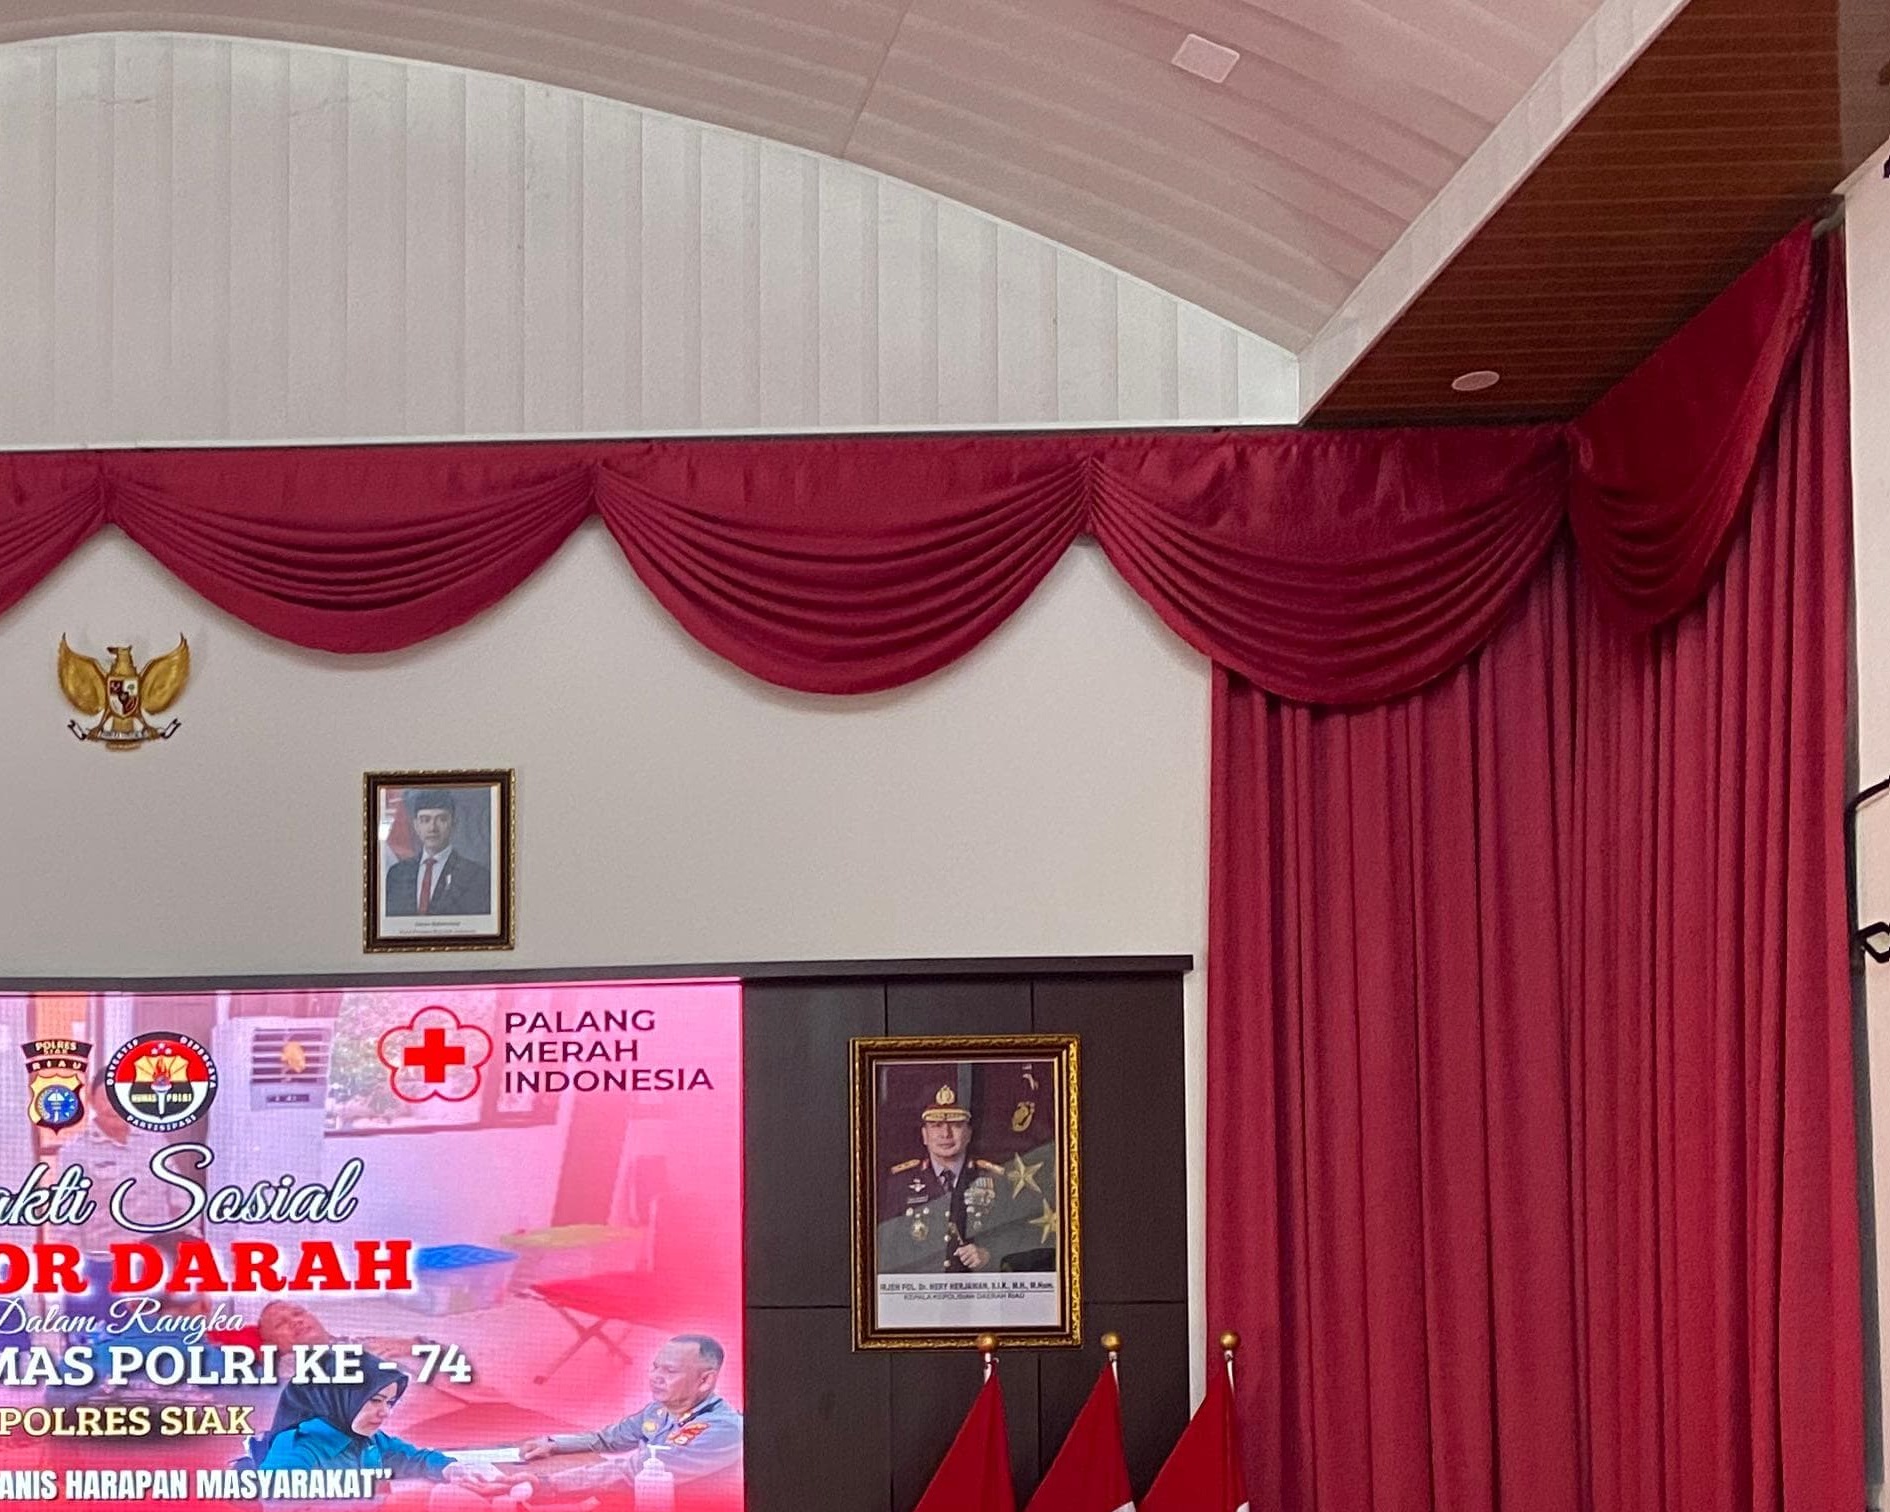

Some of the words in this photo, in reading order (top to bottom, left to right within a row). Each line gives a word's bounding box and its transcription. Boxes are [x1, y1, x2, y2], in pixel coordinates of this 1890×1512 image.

[505, 1010, 655, 1034] PALANG
[35, 1041, 77, 1051] POLRES
[505, 1039, 638, 1064] MERAH
[32, 1060, 82, 1071] RIAU
[505, 1068, 715, 1094] INDONESIA
[110, 1142, 365, 1234] Sosial
[110, 1240, 413, 1294] DARAH
[106, 1296, 245, 1345] Rangka
[108, 1345, 278, 1386] POLRI
[291, 1344, 365, 1384] KE
[378, 1360, 398, 1371] -
[411, 1344, 473, 1384] 74
[159, 1406, 255, 1437] SIAK
[65, 1469, 188, 1500] HARAPAN
[196, 1468, 392, 1500] MASYARAKAT”
